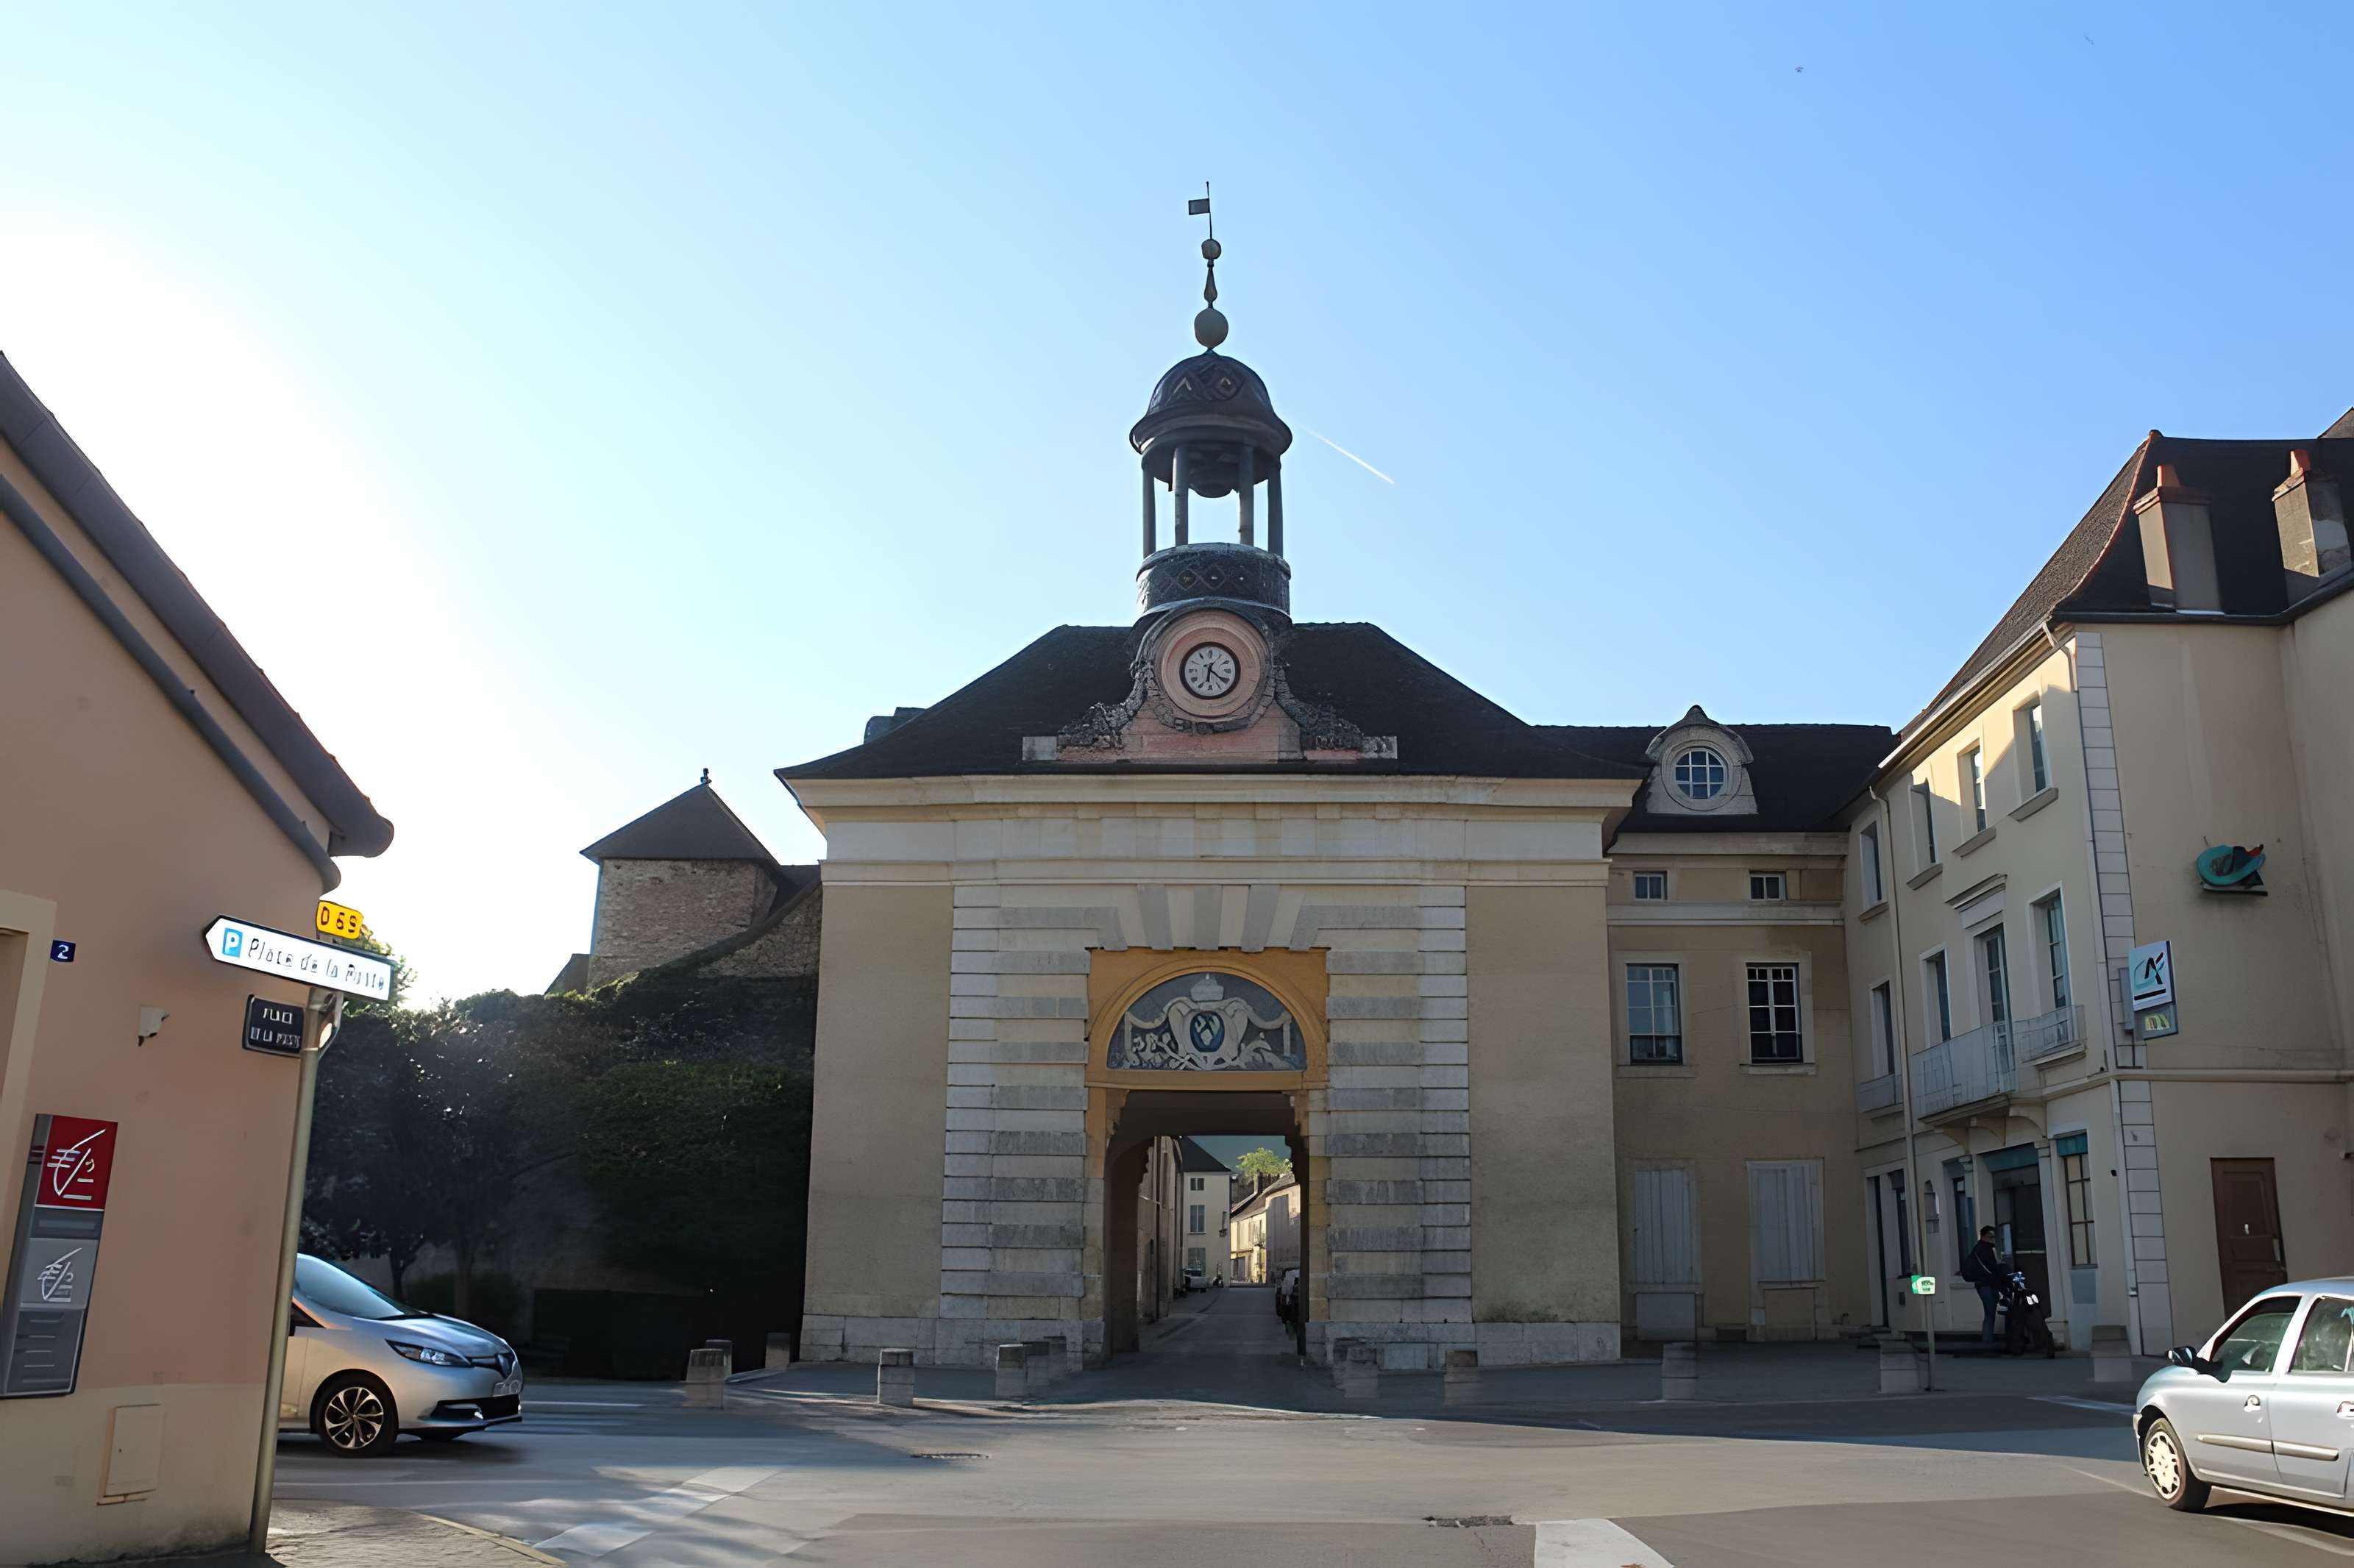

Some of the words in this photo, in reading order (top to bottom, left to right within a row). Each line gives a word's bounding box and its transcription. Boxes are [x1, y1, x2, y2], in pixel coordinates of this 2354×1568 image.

[321, 906, 330, 926] D
[57, 944, 69, 960] 2
[301, 953, 318, 974] de
